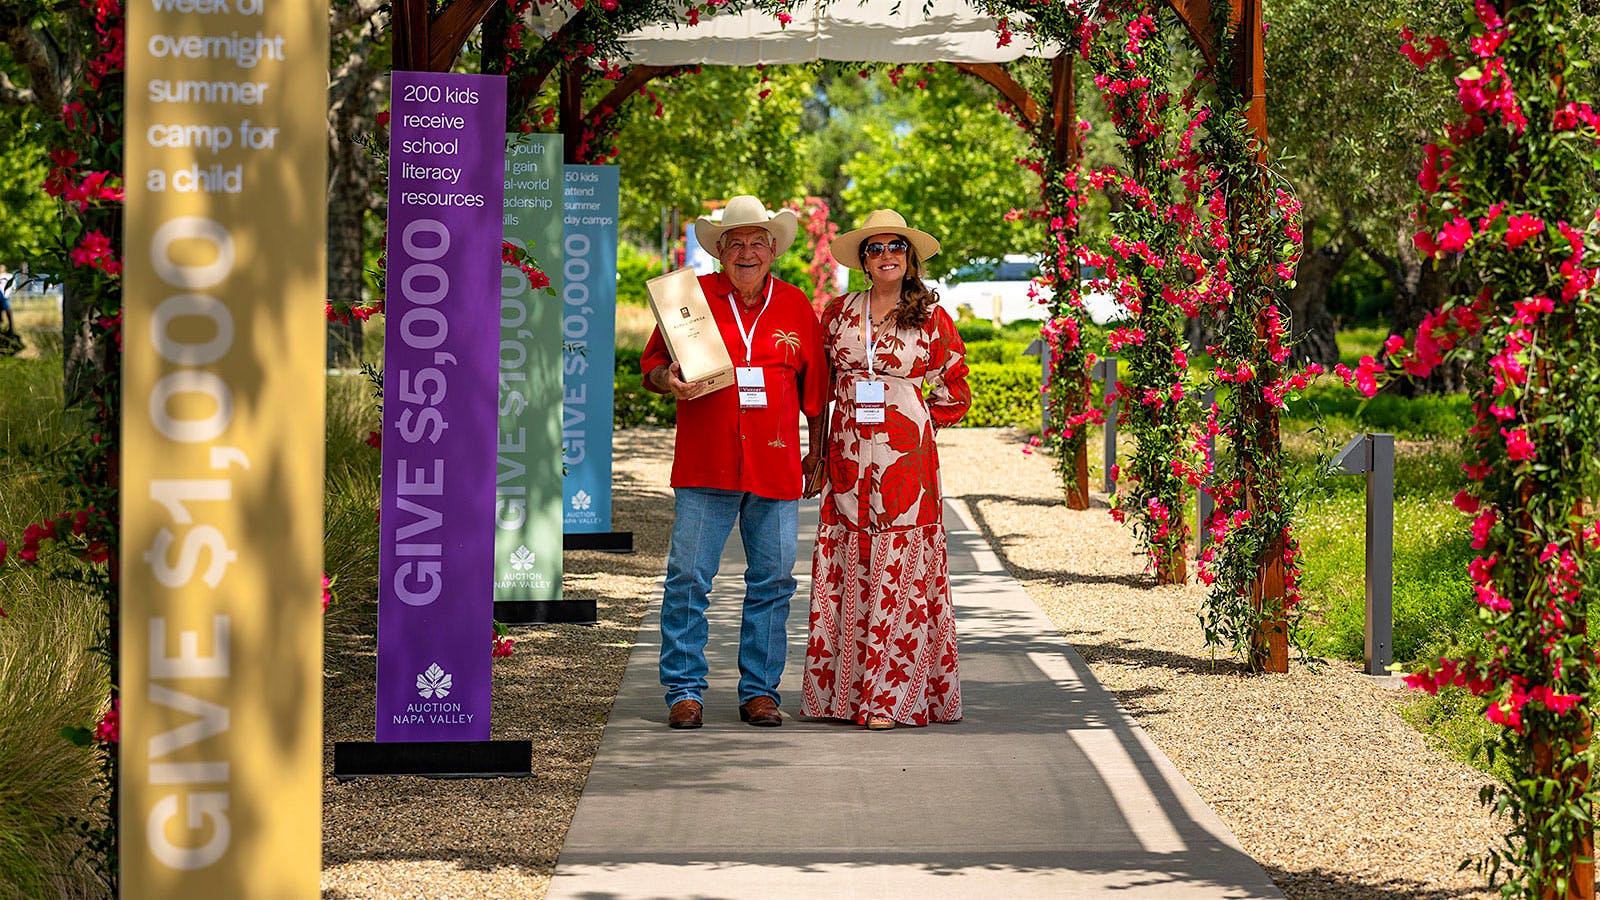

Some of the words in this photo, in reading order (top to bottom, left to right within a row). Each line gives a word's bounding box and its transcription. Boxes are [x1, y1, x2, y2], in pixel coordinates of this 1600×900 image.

[149, 32, 285, 68] overnight
[149, 79, 268, 104] summer
[404, 85, 441, 102] 200
[445, 86, 479, 104] kids
[403, 113, 465, 129] receive
[147, 124, 233, 154] camp
[240, 119, 279, 150] for
[402, 137, 459, 155] school
[512, 143, 545, 156] youth
[402, 162, 462, 184] literacy
[513, 161, 538, 175] gain
[147, 168, 166, 193] a
[173, 163, 243, 193] child
[504, 178, 550, 191] al-world
[565, 171, 579, 182] 50
[580, 172, 599, 182] kids
[401, 191, 485, 207] resources
[564, 187, 594, 196] attend
[503, 196, 553, 211] adership
[564, 202, 601, 210] summer
[502, 213, 519, 226] ills
[564, 214, 581, 226] day
[582, 216, 613, 227] camps
[563, 233, 593, 375] $10,000
[395, 219, 458, 445] $5,000
[142, 215, 251, 588] $1,000
[562, 383, 587, 465] GIVE
[495, 427, 526, 531] GIVE
[394, 459, 444, 607] GIVE
[503, 572, 543, 580] AUCTION
[494, 581, 517, 589] NAPA
[406, 703, 461, 712] AUCTION
[393, 715, 425, 724] NAPA
[429, 714, 474, 724] VALLEY
[146, 614, 231, 870] GIVE
